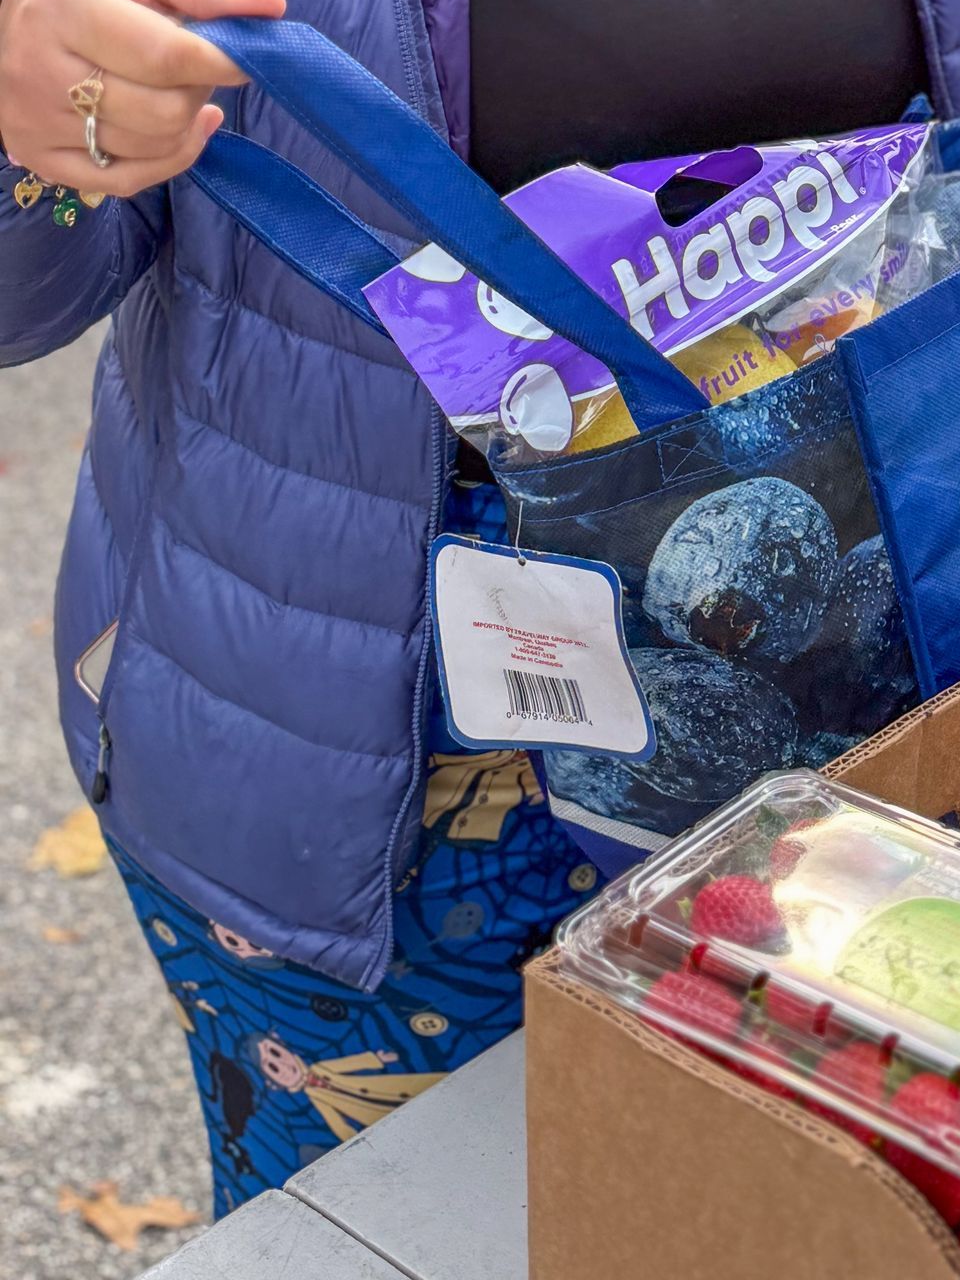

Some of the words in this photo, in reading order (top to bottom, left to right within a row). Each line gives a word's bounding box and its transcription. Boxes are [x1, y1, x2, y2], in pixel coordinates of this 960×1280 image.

[611, 152, 861, 341] Happi
[699, 350, 759, 402] fruit
[762, 322, 803, 358] for
[809, 273, 876, 326] every
